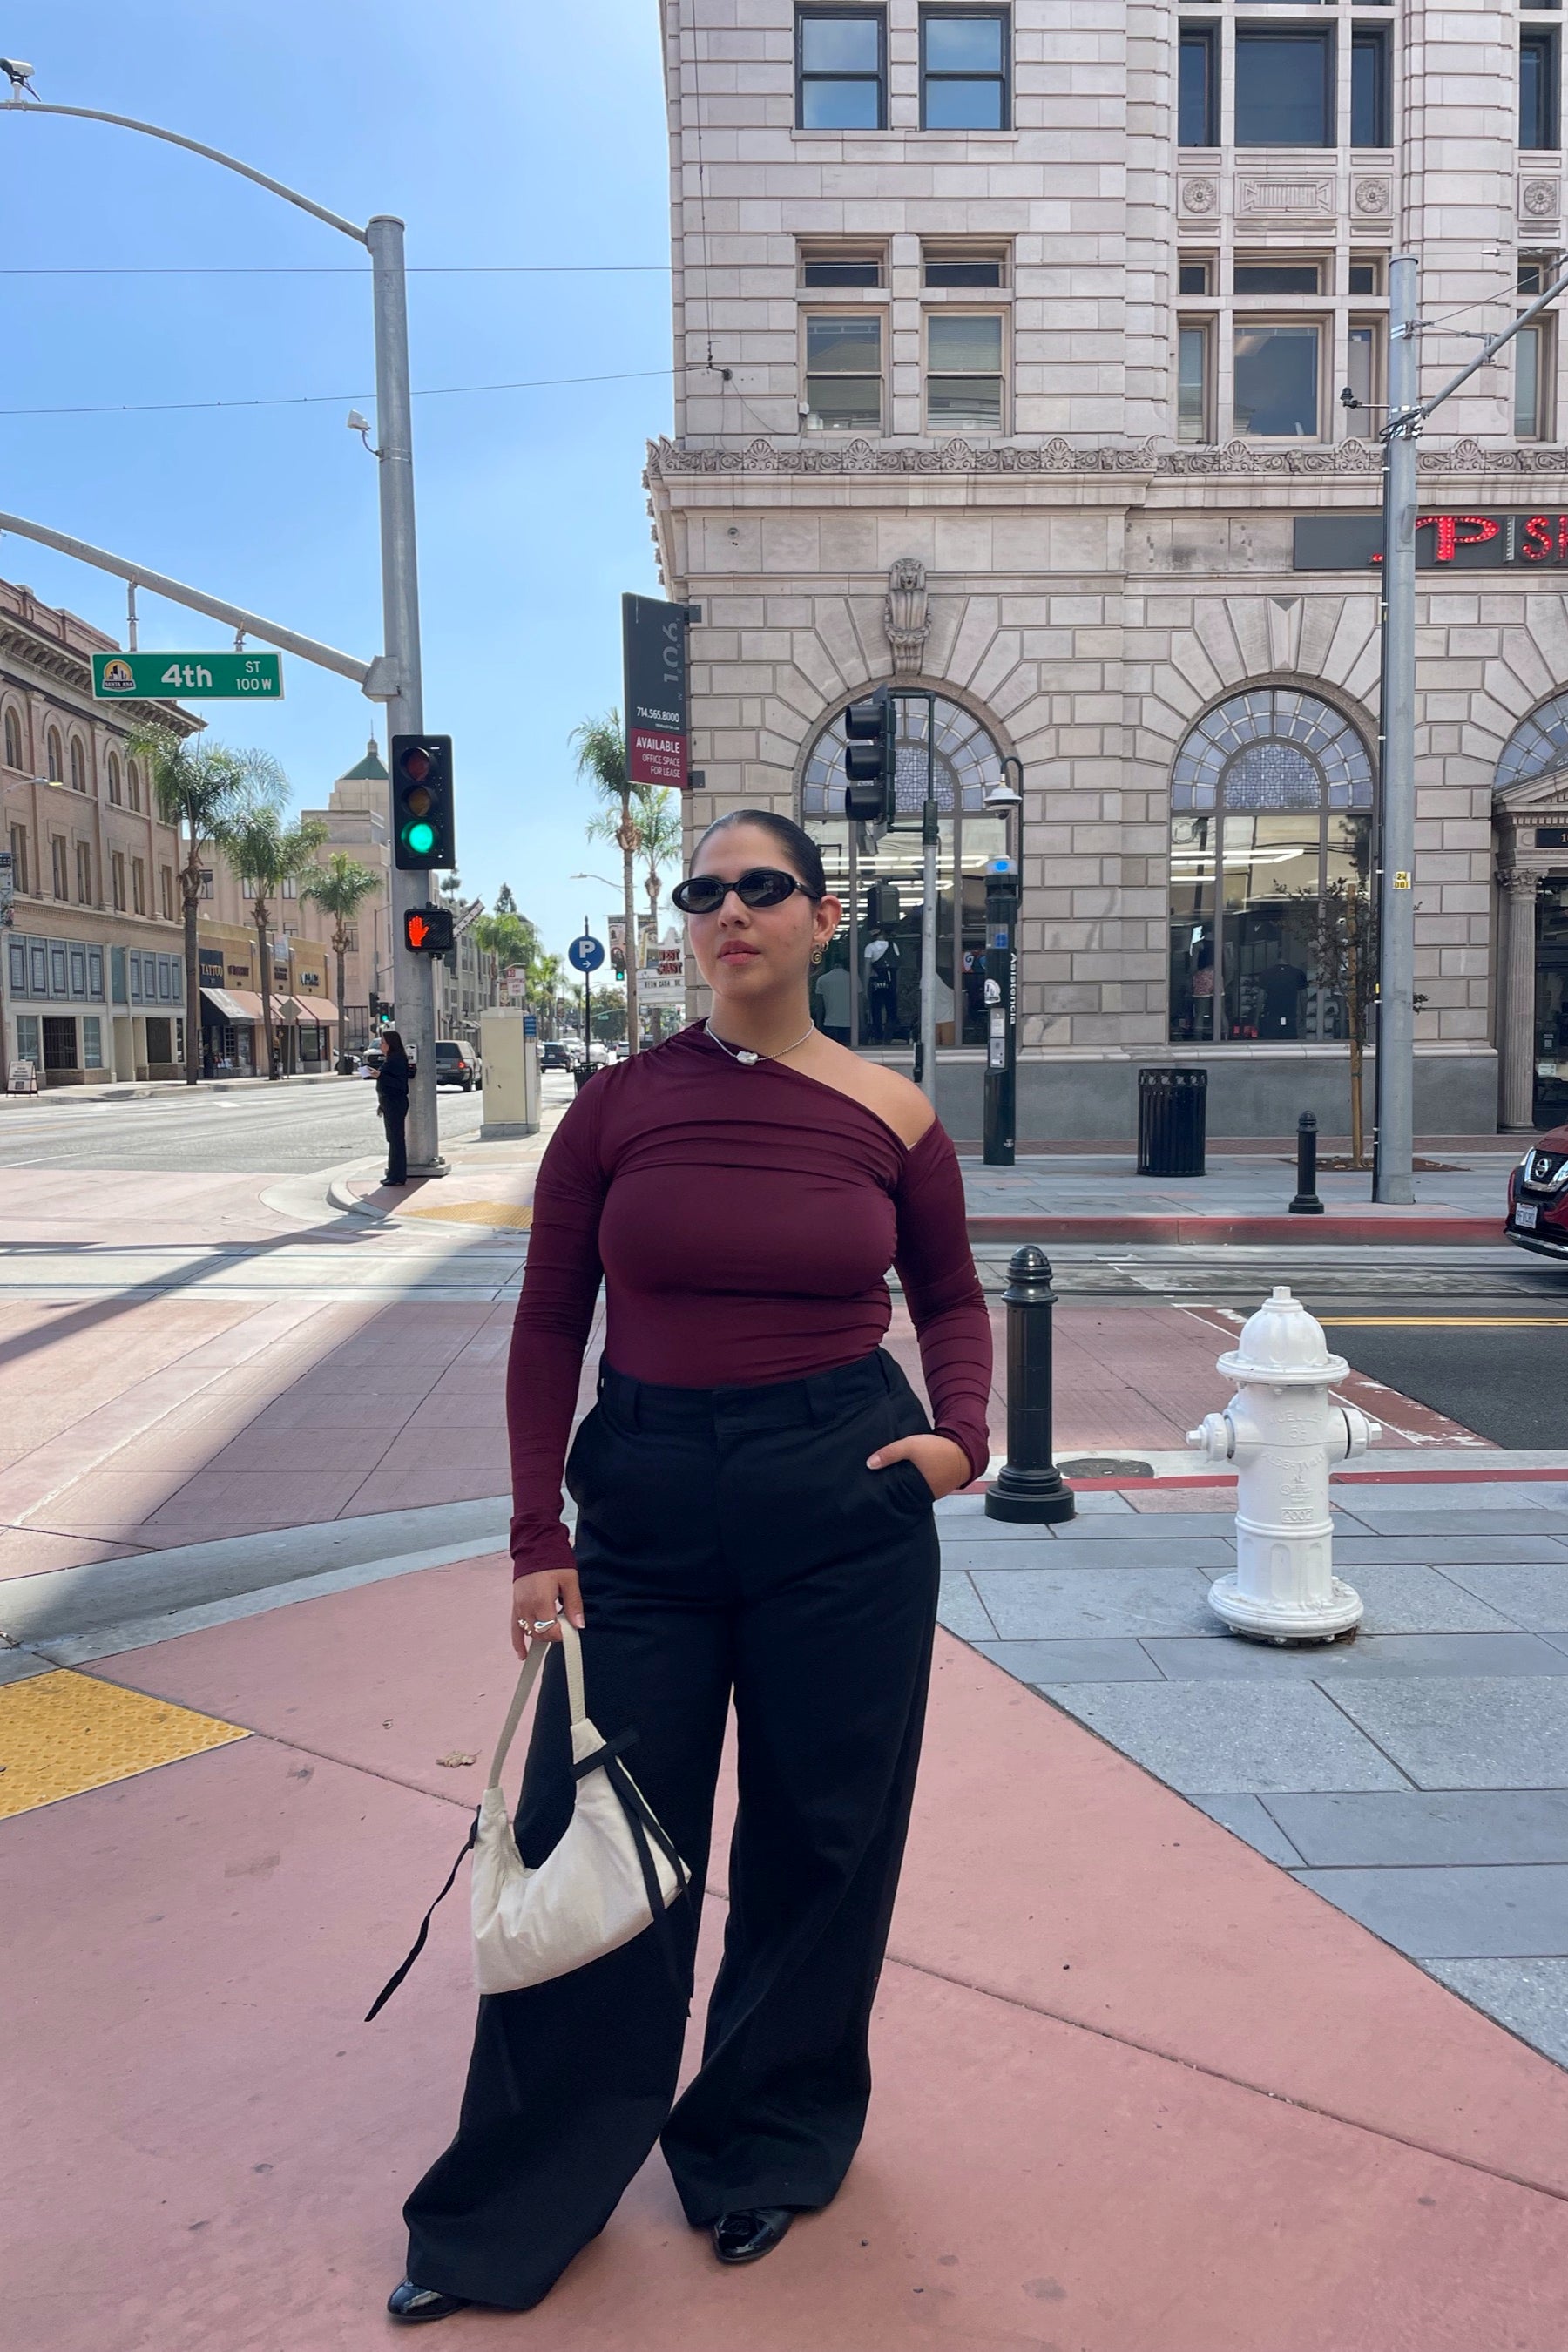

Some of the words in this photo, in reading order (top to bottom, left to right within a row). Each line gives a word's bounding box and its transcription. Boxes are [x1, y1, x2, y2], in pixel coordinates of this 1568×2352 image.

[662, 622, 679, 683] 106
[245, 660, 260, 673] ST
[161, 664, 213, 687] 4th
[236, 678, 260, 690] 100
[261, 678, 272, 691] W
[637, 706, 680, 723] 714.565.8000
[636, 736, 680, 754] AVAILABLE
[642, 753, 662, 765] OFFICE
[662, 756, 680, 767] SPACE
[650, 766, 663, 775] FOR
[663, 767, 680, 779] LEASE
[579, 941, 596, 958] P
[199, 963, 223, 977] TATTOO
